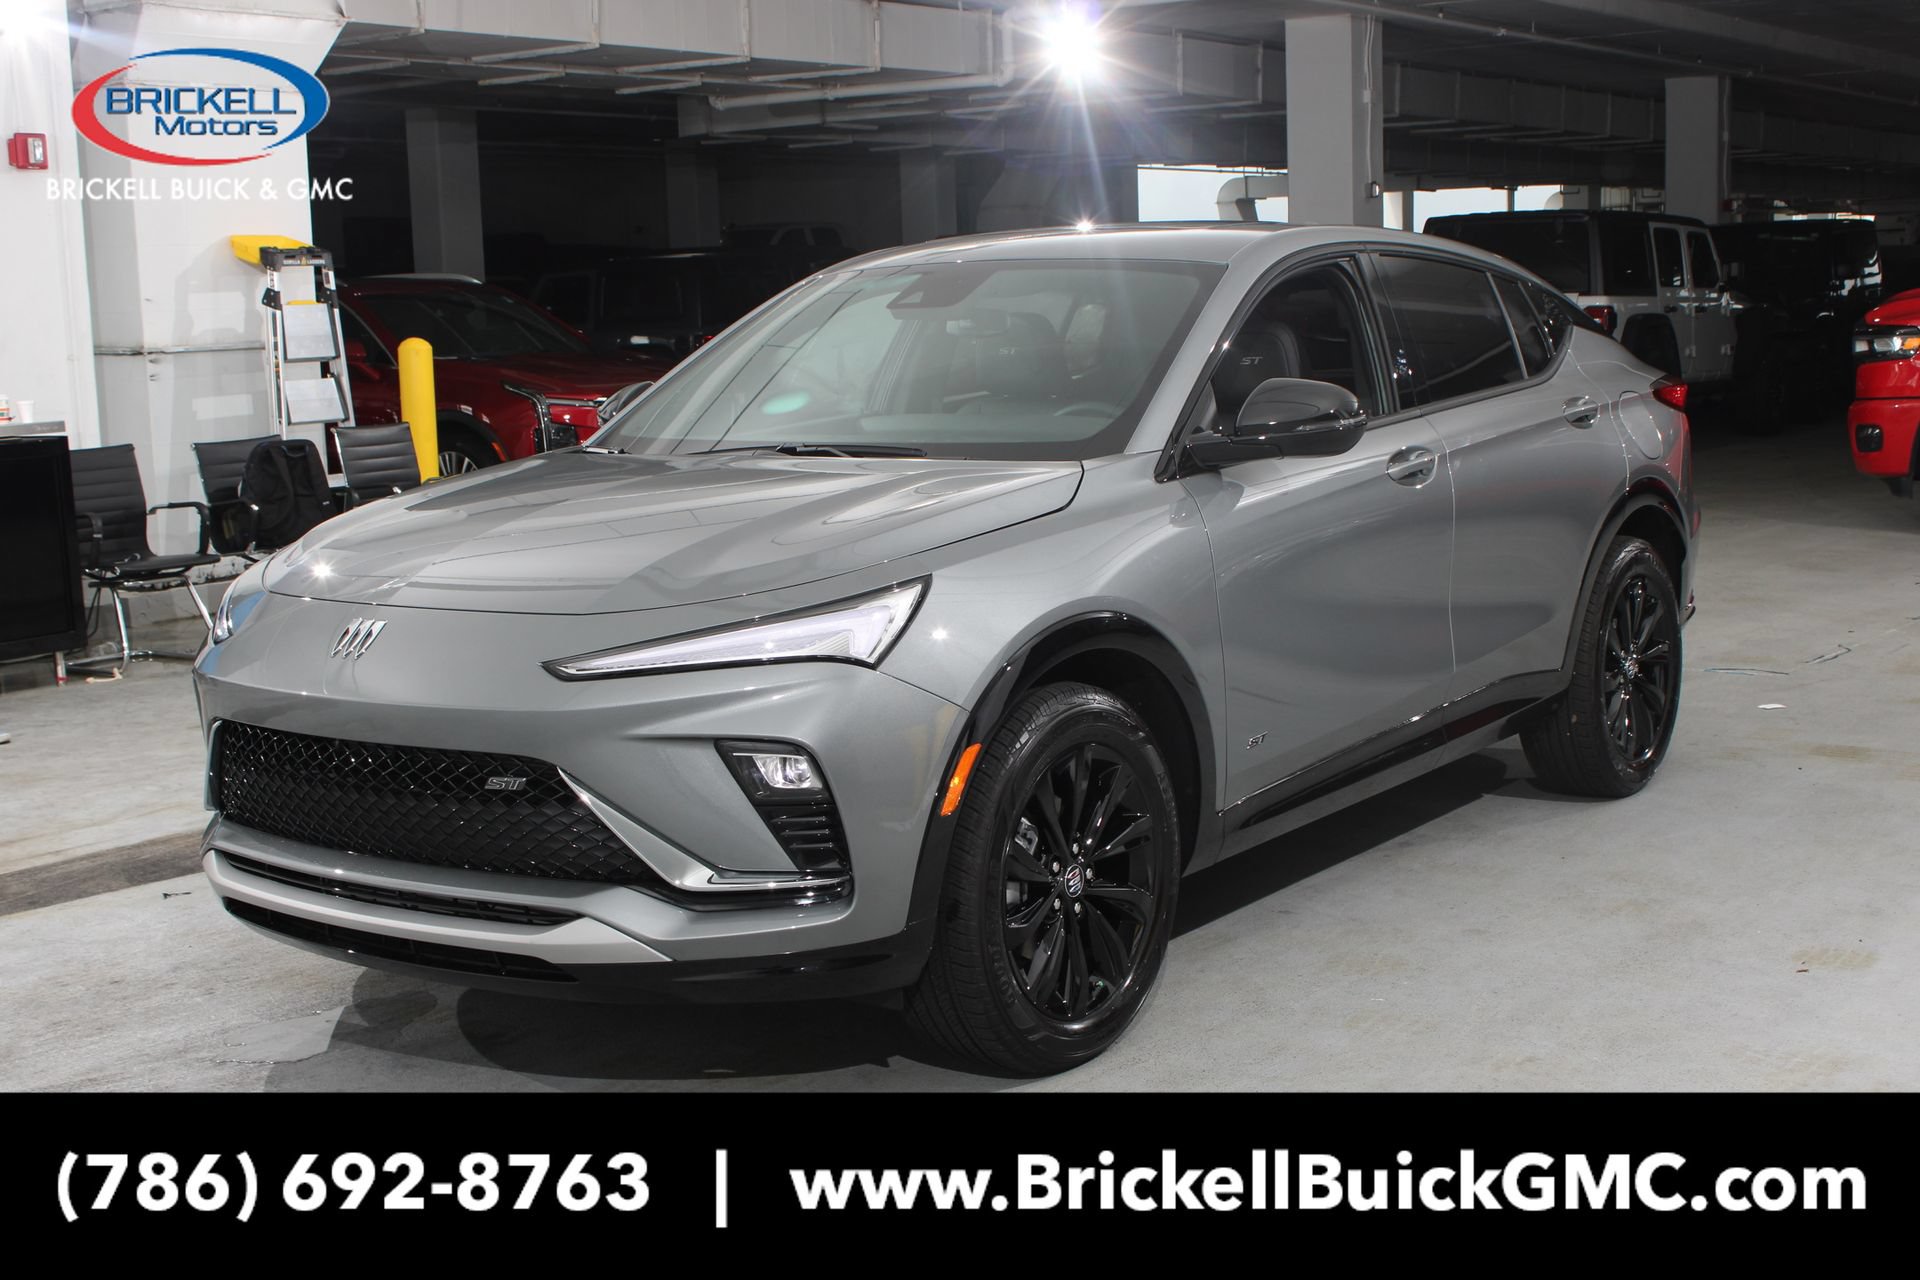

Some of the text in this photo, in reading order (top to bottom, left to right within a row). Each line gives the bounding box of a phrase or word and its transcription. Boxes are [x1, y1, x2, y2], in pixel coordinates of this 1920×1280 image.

[1239, 356, 1264, 366] ST
[1246, 730, 1269, 750] ST
[484, 776, 527, 790] ST
